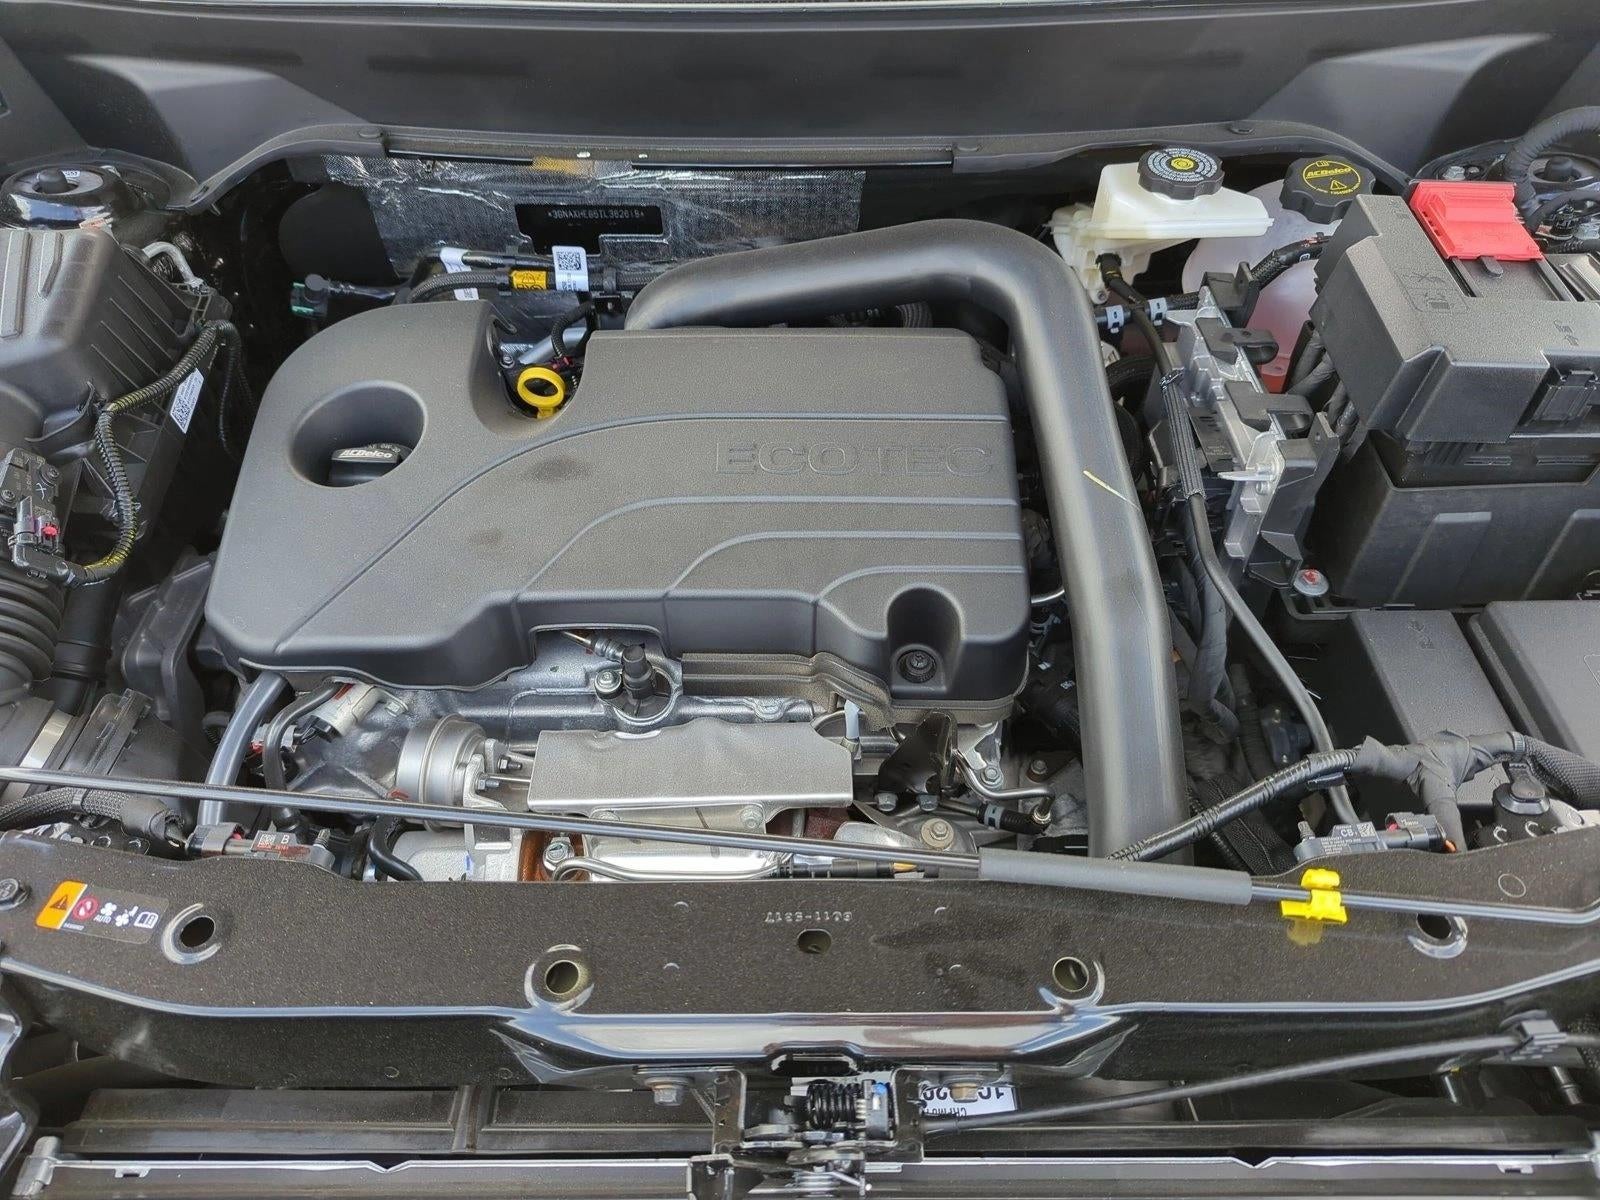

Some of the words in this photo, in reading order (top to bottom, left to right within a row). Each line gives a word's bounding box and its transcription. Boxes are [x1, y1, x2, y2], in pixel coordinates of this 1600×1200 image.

[1306, 168, 1351, 178] ACDelco
[339, 449, 393, 459] ACDelco
[716, 441, 992, 475] ECOTEC
[93, 915, 112, 924] AUTO
